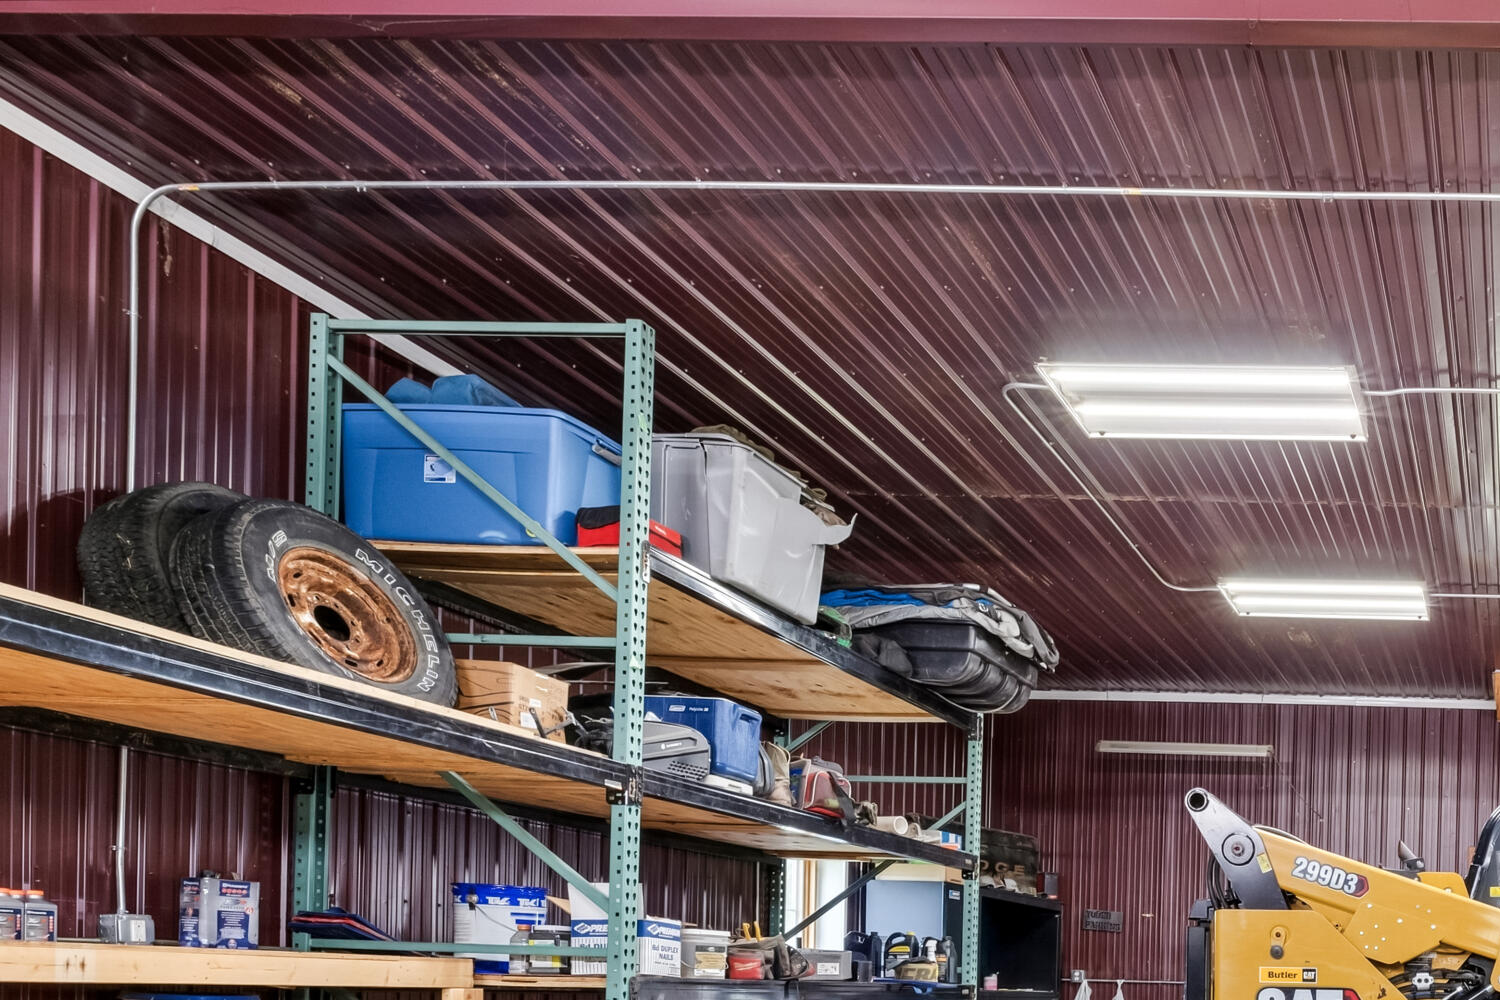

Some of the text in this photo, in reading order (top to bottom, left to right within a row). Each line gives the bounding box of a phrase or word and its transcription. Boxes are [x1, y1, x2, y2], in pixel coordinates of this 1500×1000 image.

[354, 547, 440, 693] MICHELIN
[1291, 856, 1358, 895] 299D3
[658, 953, 674, 961] NAILS
[1267, 970, 1316, 981] Butler CAT
